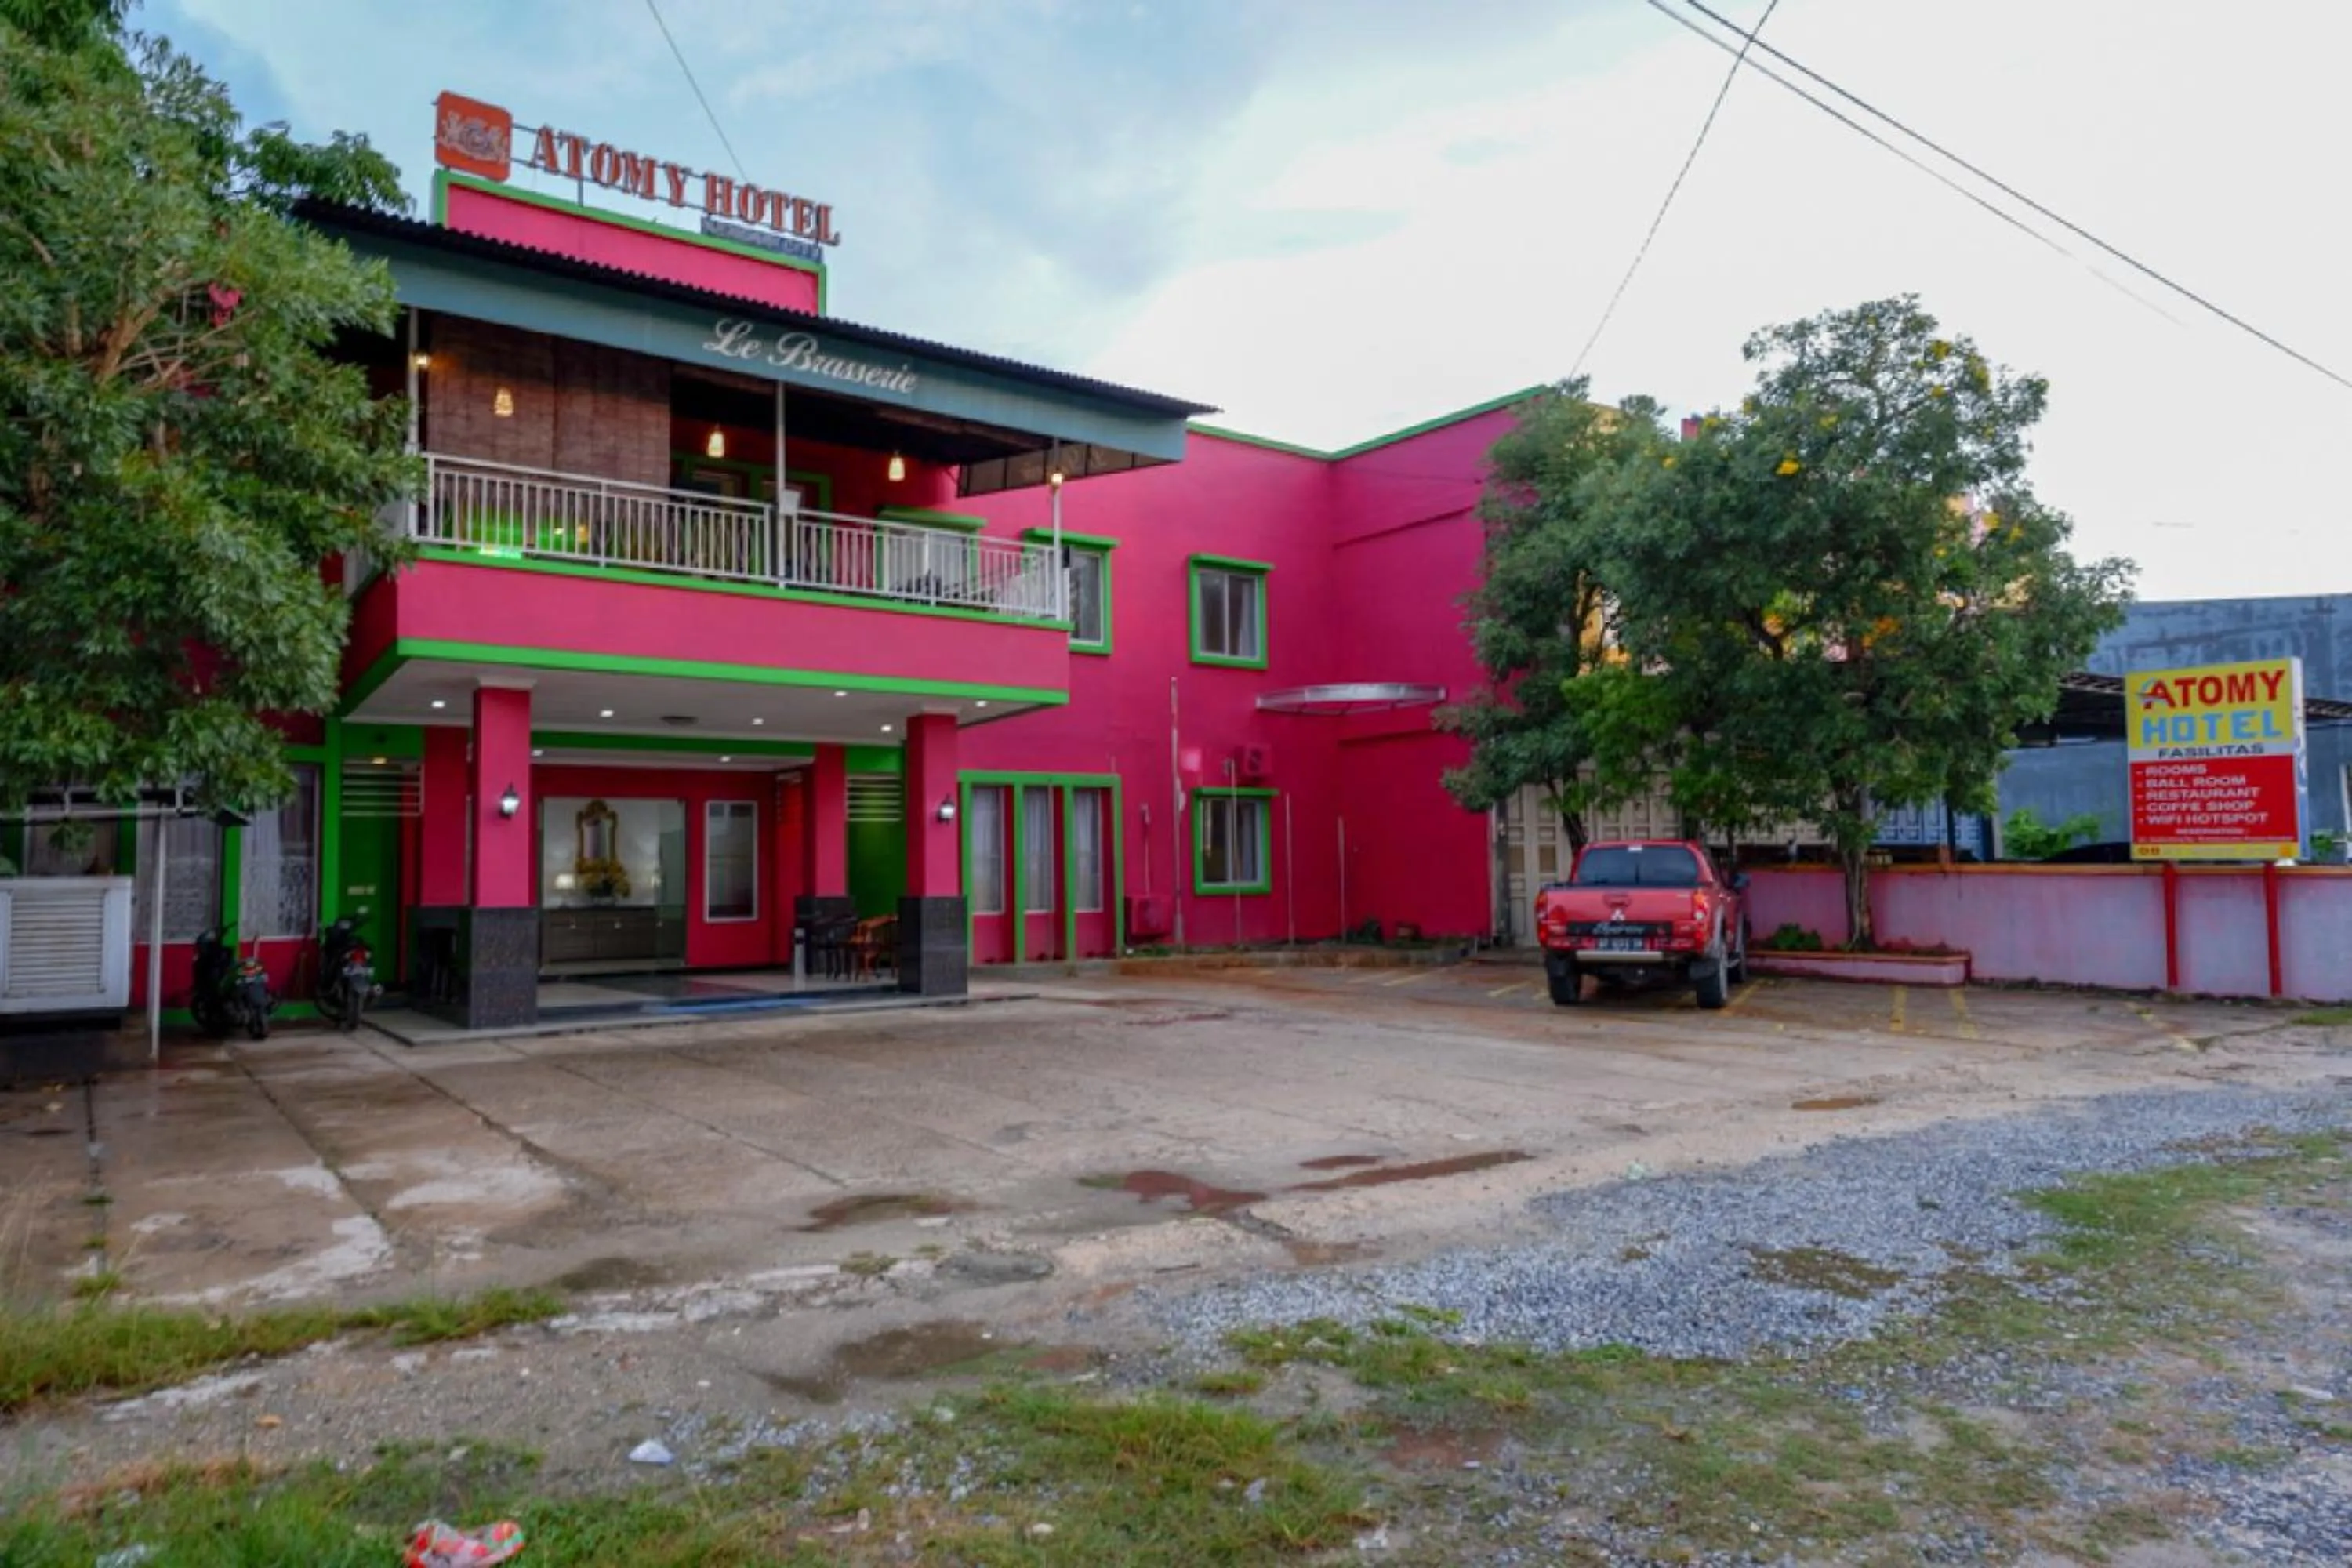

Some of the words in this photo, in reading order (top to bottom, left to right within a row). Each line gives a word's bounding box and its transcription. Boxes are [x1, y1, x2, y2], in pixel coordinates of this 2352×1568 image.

[529, 125, 692, 207] ATOMY
[705, 172, 840, 246] HOTEL
[702, 317, 763, 360] Le
[767, 332, 920, 394] Brasserie
[2143, 670, 2285, 710] ATOMY
[2142, 710, 2284, 744] HOTEL
[2158, 742, 2265, 759] FASILITAS
[2145, 764, 2207, 776] ROOMS
[2145, 777, 2190, 788] BALL
[2193, 775, 2246, 786] ROOM
[2146, 786, 2262, 800] RESTAURANT
[2205, 800, 2256, 811] SHOP
[2185, 812, 2269, 825] HOTSPOT
